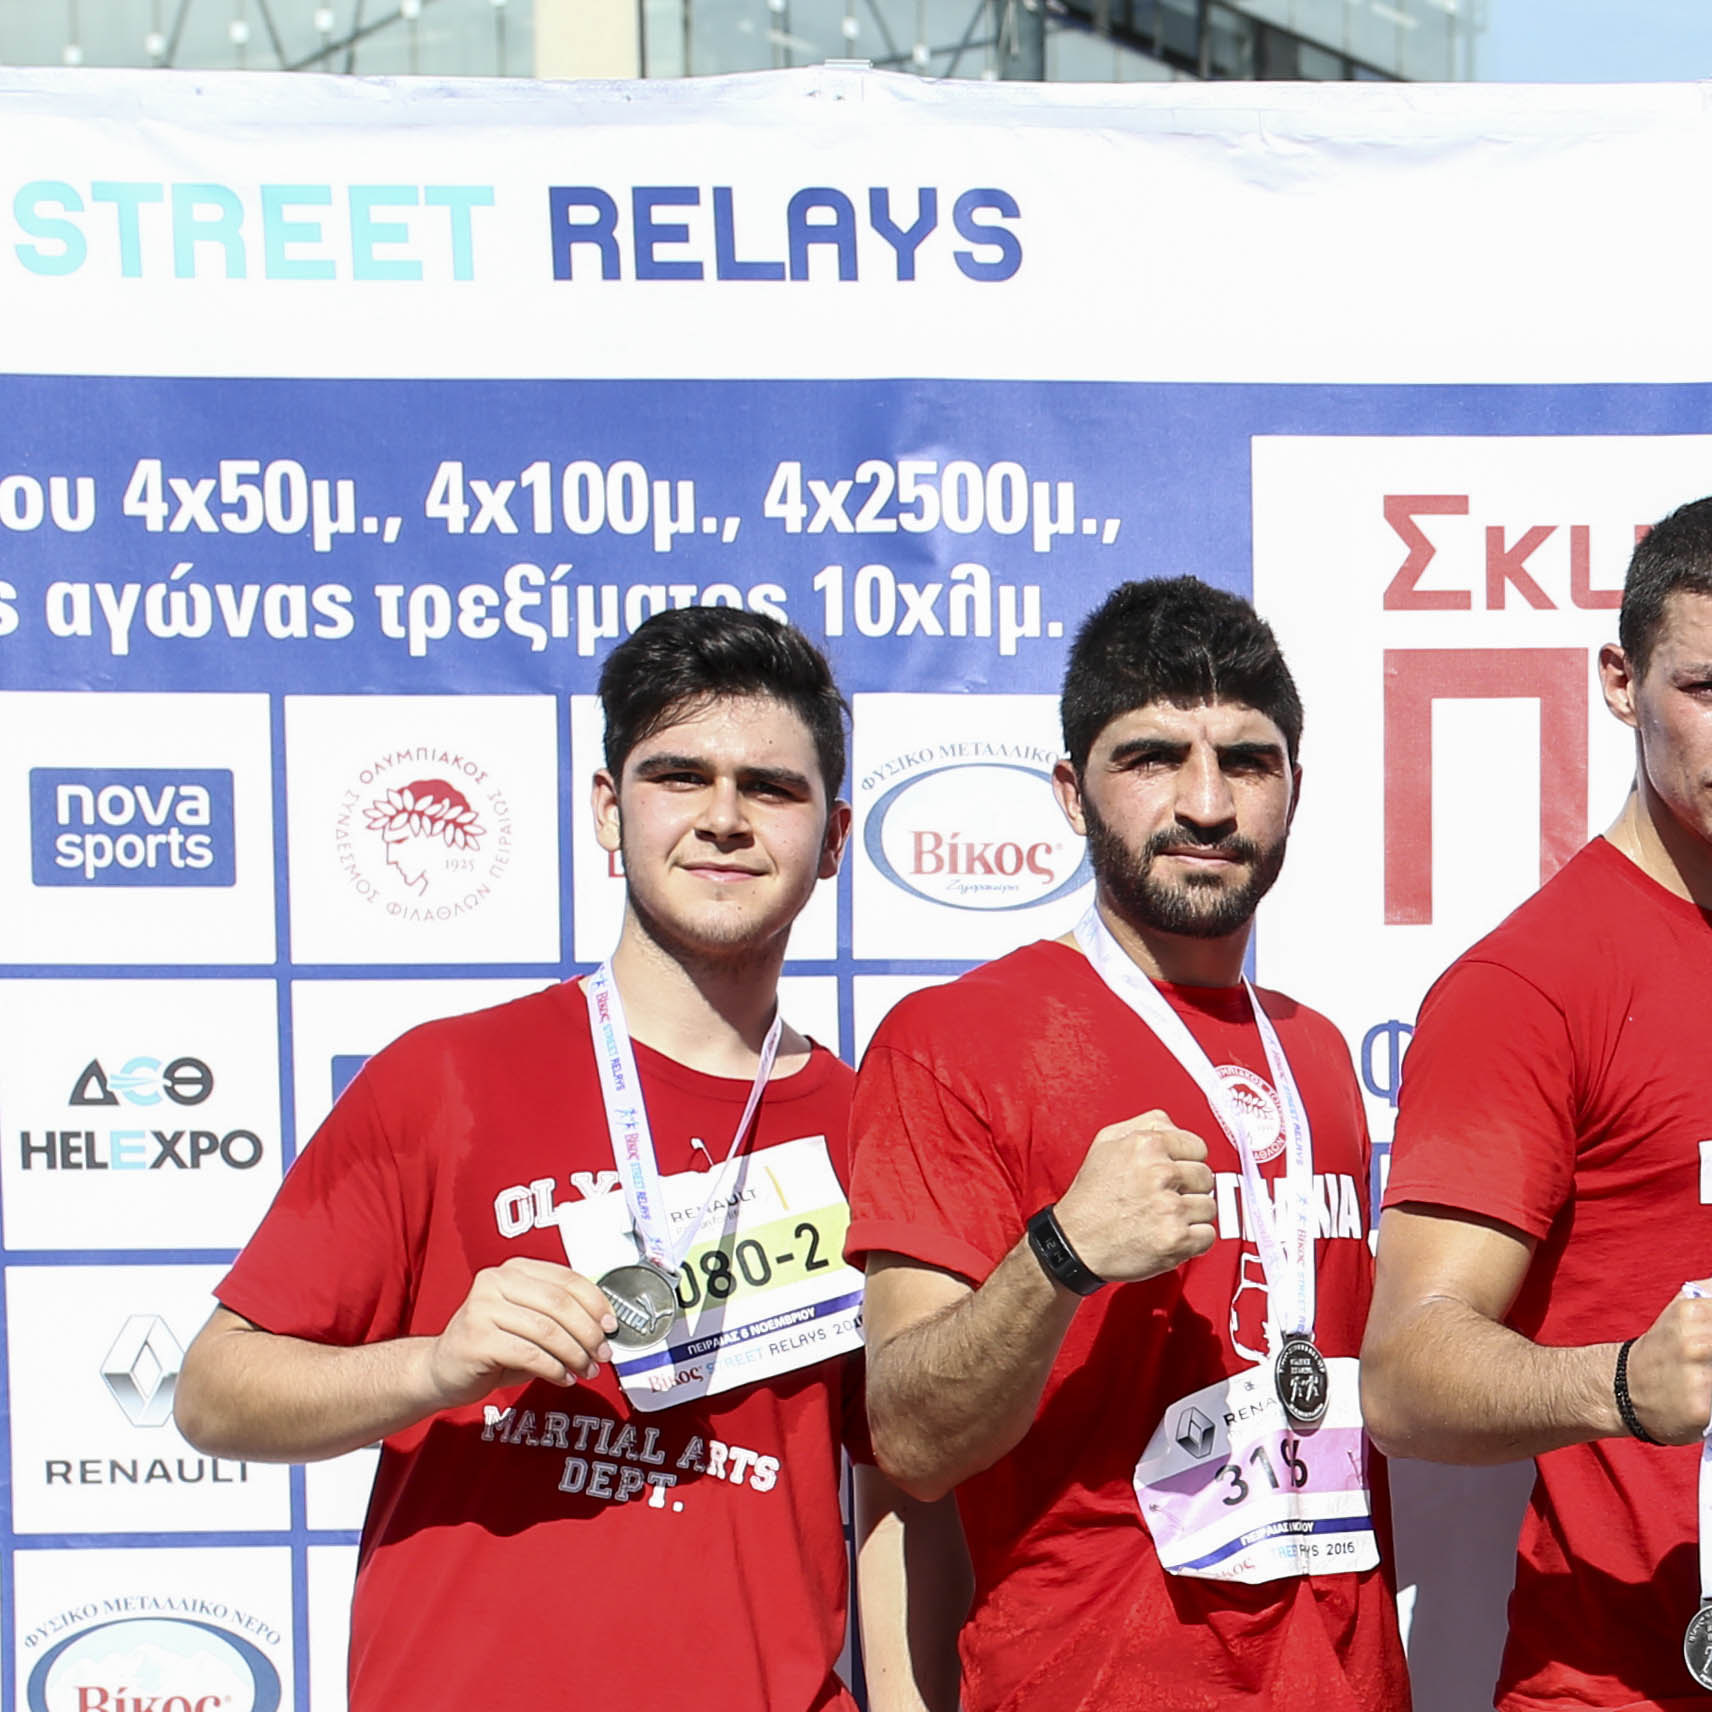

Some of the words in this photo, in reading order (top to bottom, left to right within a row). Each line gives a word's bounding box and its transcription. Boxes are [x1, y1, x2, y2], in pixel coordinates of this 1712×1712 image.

[14, 180, 496, 282] STREET
[547, 186, 1024, 284] RELAYS
[46, 564, 354, 655] αγώνας
[358, 746, 488, 786] ΟΛΥΜΠΙΑΚΟΣ
[55, 784, 211, 827] nova
[55, 829, 214, 880] sports
[909, 829, 1056, 885] Βίκος
[19, 1129, 264, 1171] HELEXPO
[768, 1329, 828, 1358] RELAYS
[480, 1405, 668, 1463] MARTIAL
[676, 1437, 781, 1493] ARTS
[559, 1456, 684, 1512] DEPT.
[232, 1610, 282, 1647] ΝΕΡΟ
